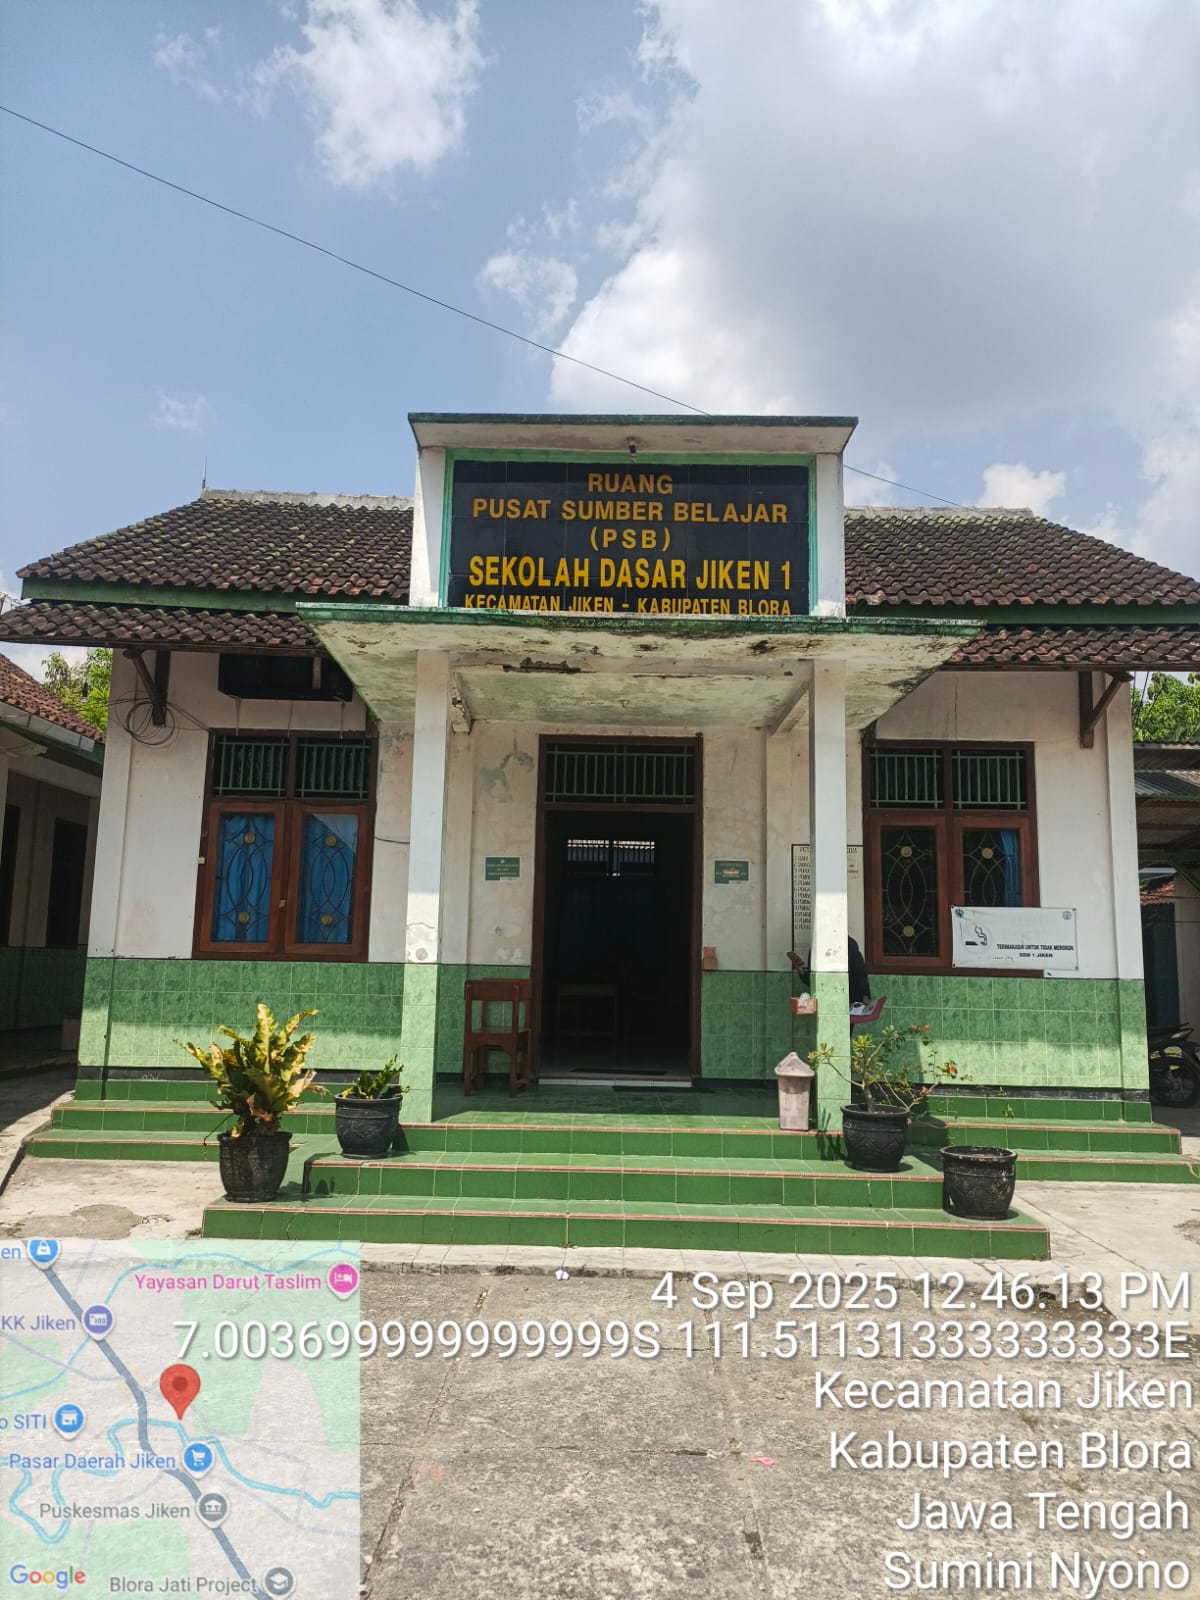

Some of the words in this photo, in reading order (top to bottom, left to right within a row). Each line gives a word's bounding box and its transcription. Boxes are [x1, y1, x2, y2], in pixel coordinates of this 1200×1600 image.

[587, 473, 674, 494] RUANG
[472, 498, 552, 519] PUSAT
[561, 500, 663, 521] SUMBER
[673, 502, 788, 524] BELAJAR
[589, 525, 671, 552] (PSB)
[468, 555, 590, 588] SEKOLAH
[599, 558, 686, 588] DASAR
[696, 559, 770, 590] JIKEN
[781, 561, 791, 590] 1
[464, 593, 560, 612] KECAMATAN
[568, 596, 614, 613] JIKEN
[637, 598, 730, 615] KABUPATEN
[738, 599, 791, 616] BLORA
